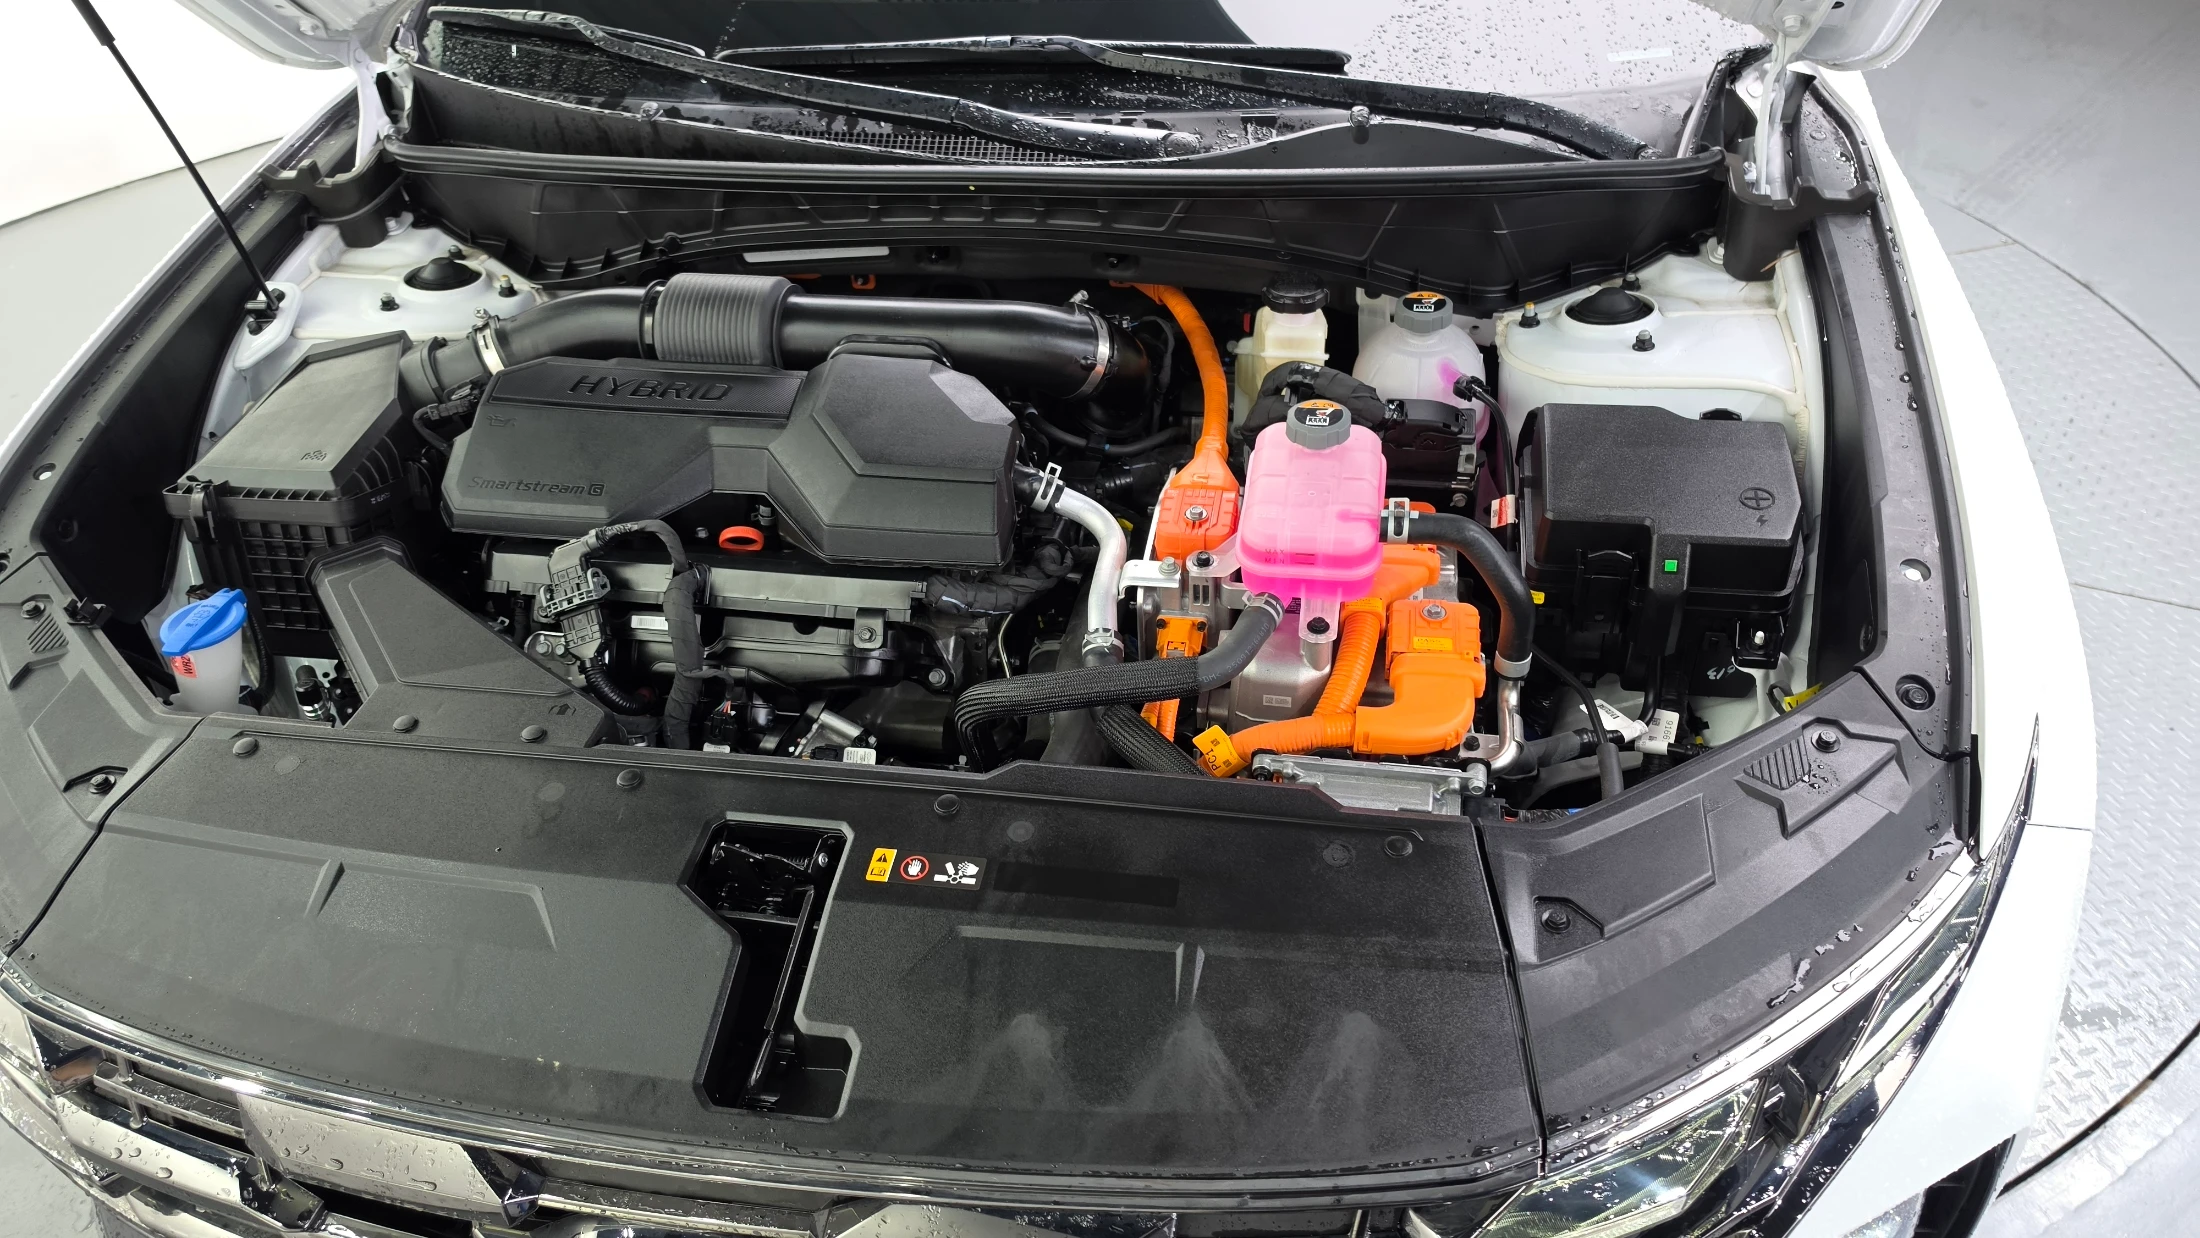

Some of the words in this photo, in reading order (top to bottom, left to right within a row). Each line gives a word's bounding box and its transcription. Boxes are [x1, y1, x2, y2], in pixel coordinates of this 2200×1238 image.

[567, 374, 734, 402] HYBRID
[468, 476, 587, 495] Smartstream
[588, 483, 606, 497] G
[1662, 720, 1674, 743] 9166
[1206, 748, 1222, 771] PC1
